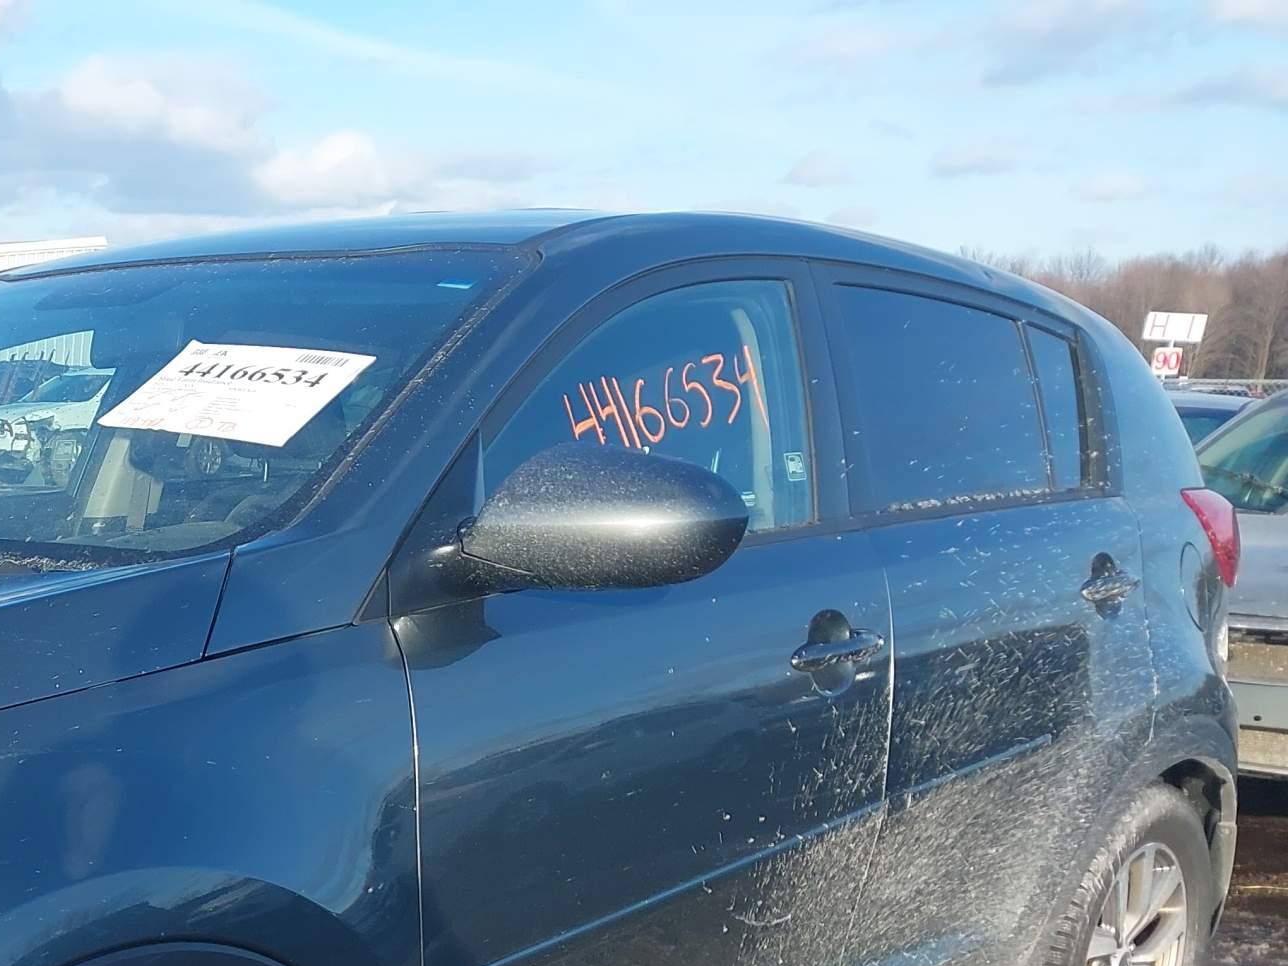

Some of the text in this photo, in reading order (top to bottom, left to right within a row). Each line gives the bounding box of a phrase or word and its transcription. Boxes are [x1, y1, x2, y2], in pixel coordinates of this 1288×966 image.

[1155, 351, 1180, 370] 90
[178, 362, 328, 387] 44166534
[563, 345, 768, 449] 44166534
